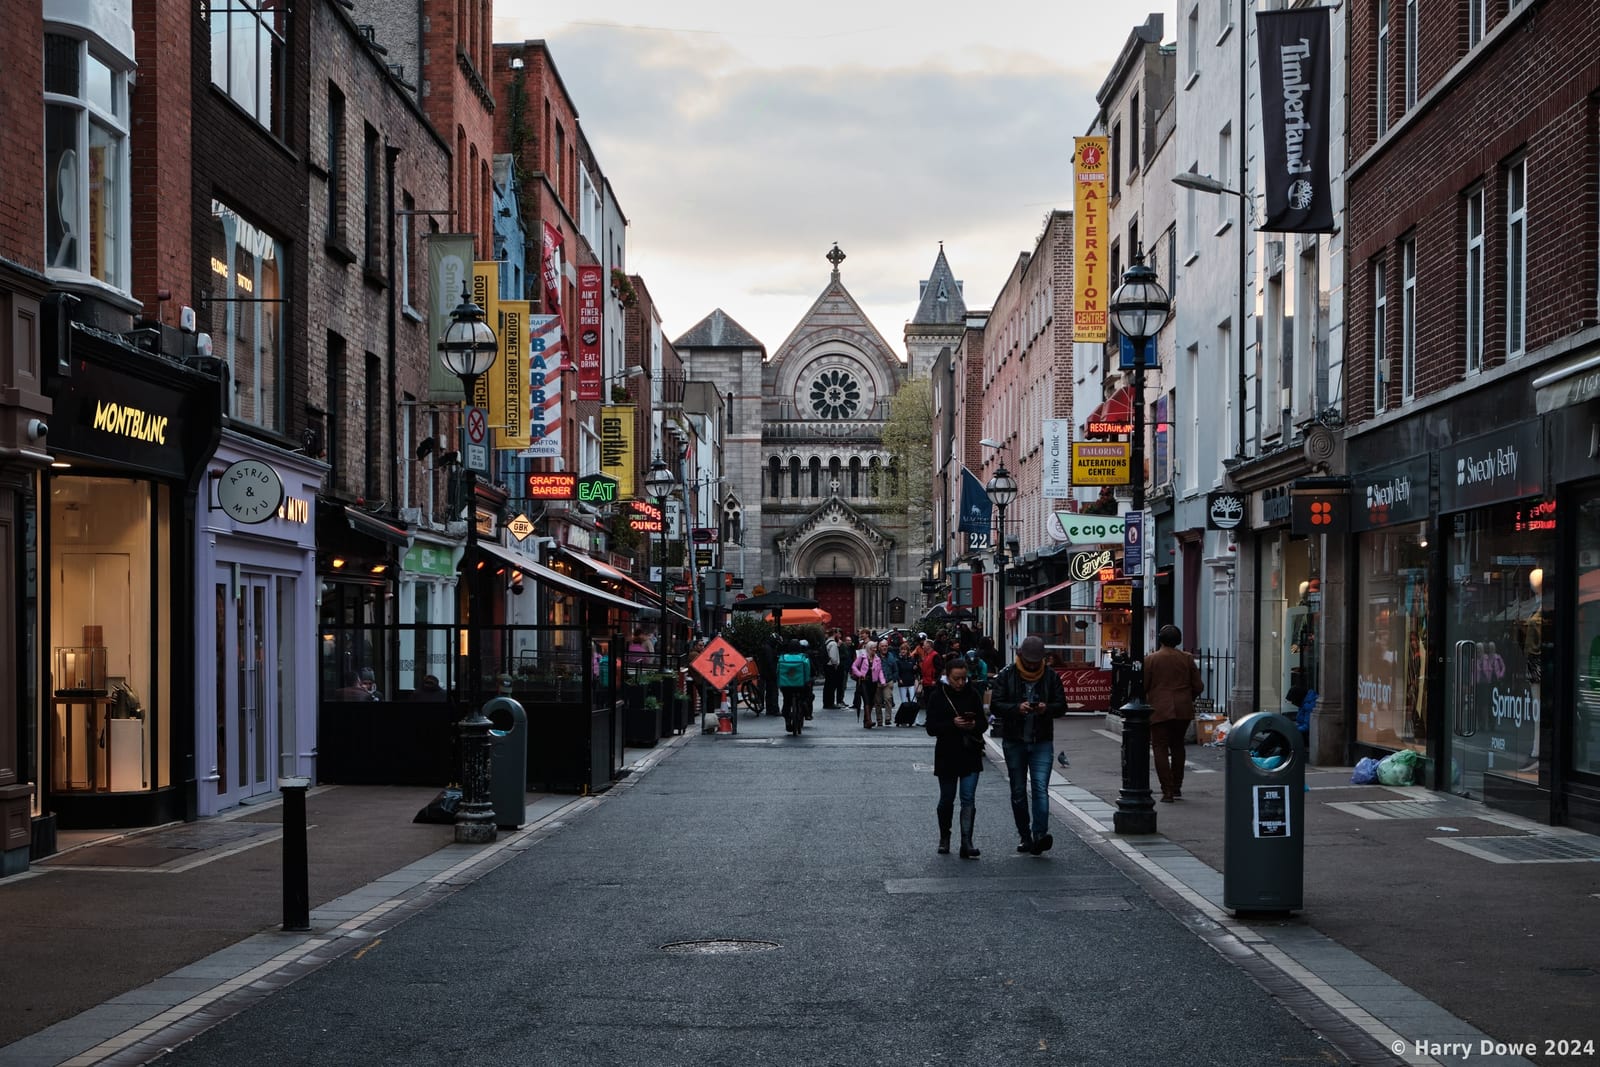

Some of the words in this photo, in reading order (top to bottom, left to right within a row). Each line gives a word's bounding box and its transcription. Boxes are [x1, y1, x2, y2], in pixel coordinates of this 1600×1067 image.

[1280, 38, 1312, 175] Timberland
[1084, 189, 1098, 310] ALTERATION
[446, 263, 458, 310] Smiles
[581, 290, 598, 299] AIN'T
[580, 307, 599, 316] FINER
[585, 299, 595, 308] NO
[580, 316, 599, 325] DINER
[1077, 312, 1105, 324] CENTRE
[507, 312, 517, 356] GOURMET
[580, 360, 599, 368] DRINK
[584, 353, 596, 361] EAT
[507, 359, 517, 394] BURGER
[531, 337, 548, 438] BARBER
[93, 400, 168, 445] MONTBLANC
[507, 397, 517, 438] KITCHEN
[603, 417, 628, 467] GOTHAM
[1051, 435, 1060, 456] Clinic
[1082, 447, 1122, 456] TAILORING
[1051, 459, 1060, 484] Trinity
[1078, 459, 1126, 467] ALTERATIONS
[1088, 468, 1116, 476] CENTRE
[1467, 451, 1496, 487] Sweaty
[1497, 445, 1519, 480] Betty
[230, 467, 270, 486] ASTRID
[529, 476, 574, 485] GRAFTON
[246, 486, 255, 497] &
[532, 486, 571, 495] BARBER
[578, 480, 616, 501] EAT
[1373, 482, 1394, 510] Sweaty
[1395, 475, 1411, 504] Betty
[233, 500, 269, 516] MIYU
[287, 495, 308, 524] MIYU
[513, 523, 529, 532] GBK
[1069, 526, 1079, 536] e
[1082, 525, 1106, 538] cig
[969, 532, 987, 549] 22
[1070, 551, 1114, 581] Cave
[1358, 674, 1377, 709] Spring
[1378, 676, 1382, 703] it
[1383, 684, 1392, 705] on
[1492, 687, 1522, 728] Spring
[1524, 688, 1530, 721] it
[1532, 698, 1541, 722] o
[1491, 737, 1505, 751] POWER
